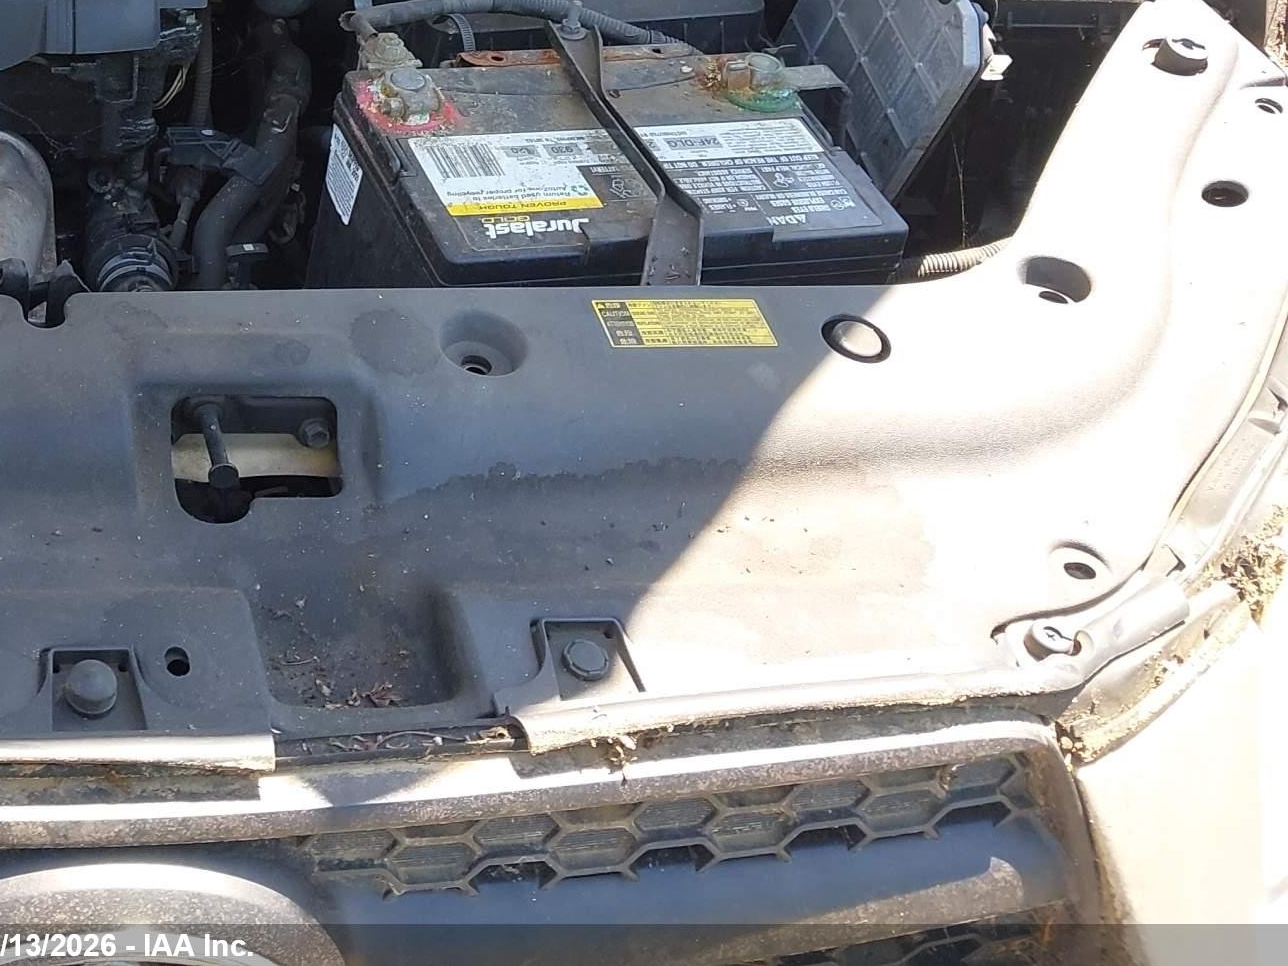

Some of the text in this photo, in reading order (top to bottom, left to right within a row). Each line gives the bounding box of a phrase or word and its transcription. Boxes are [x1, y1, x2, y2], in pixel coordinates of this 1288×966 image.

[551, 146, 573, 154] 930
[479, 201, 567, 211] PROVEN TOUGH
[481, 215, 530, 224] GOLD
[602, 310, 632, 318] CAUTION
